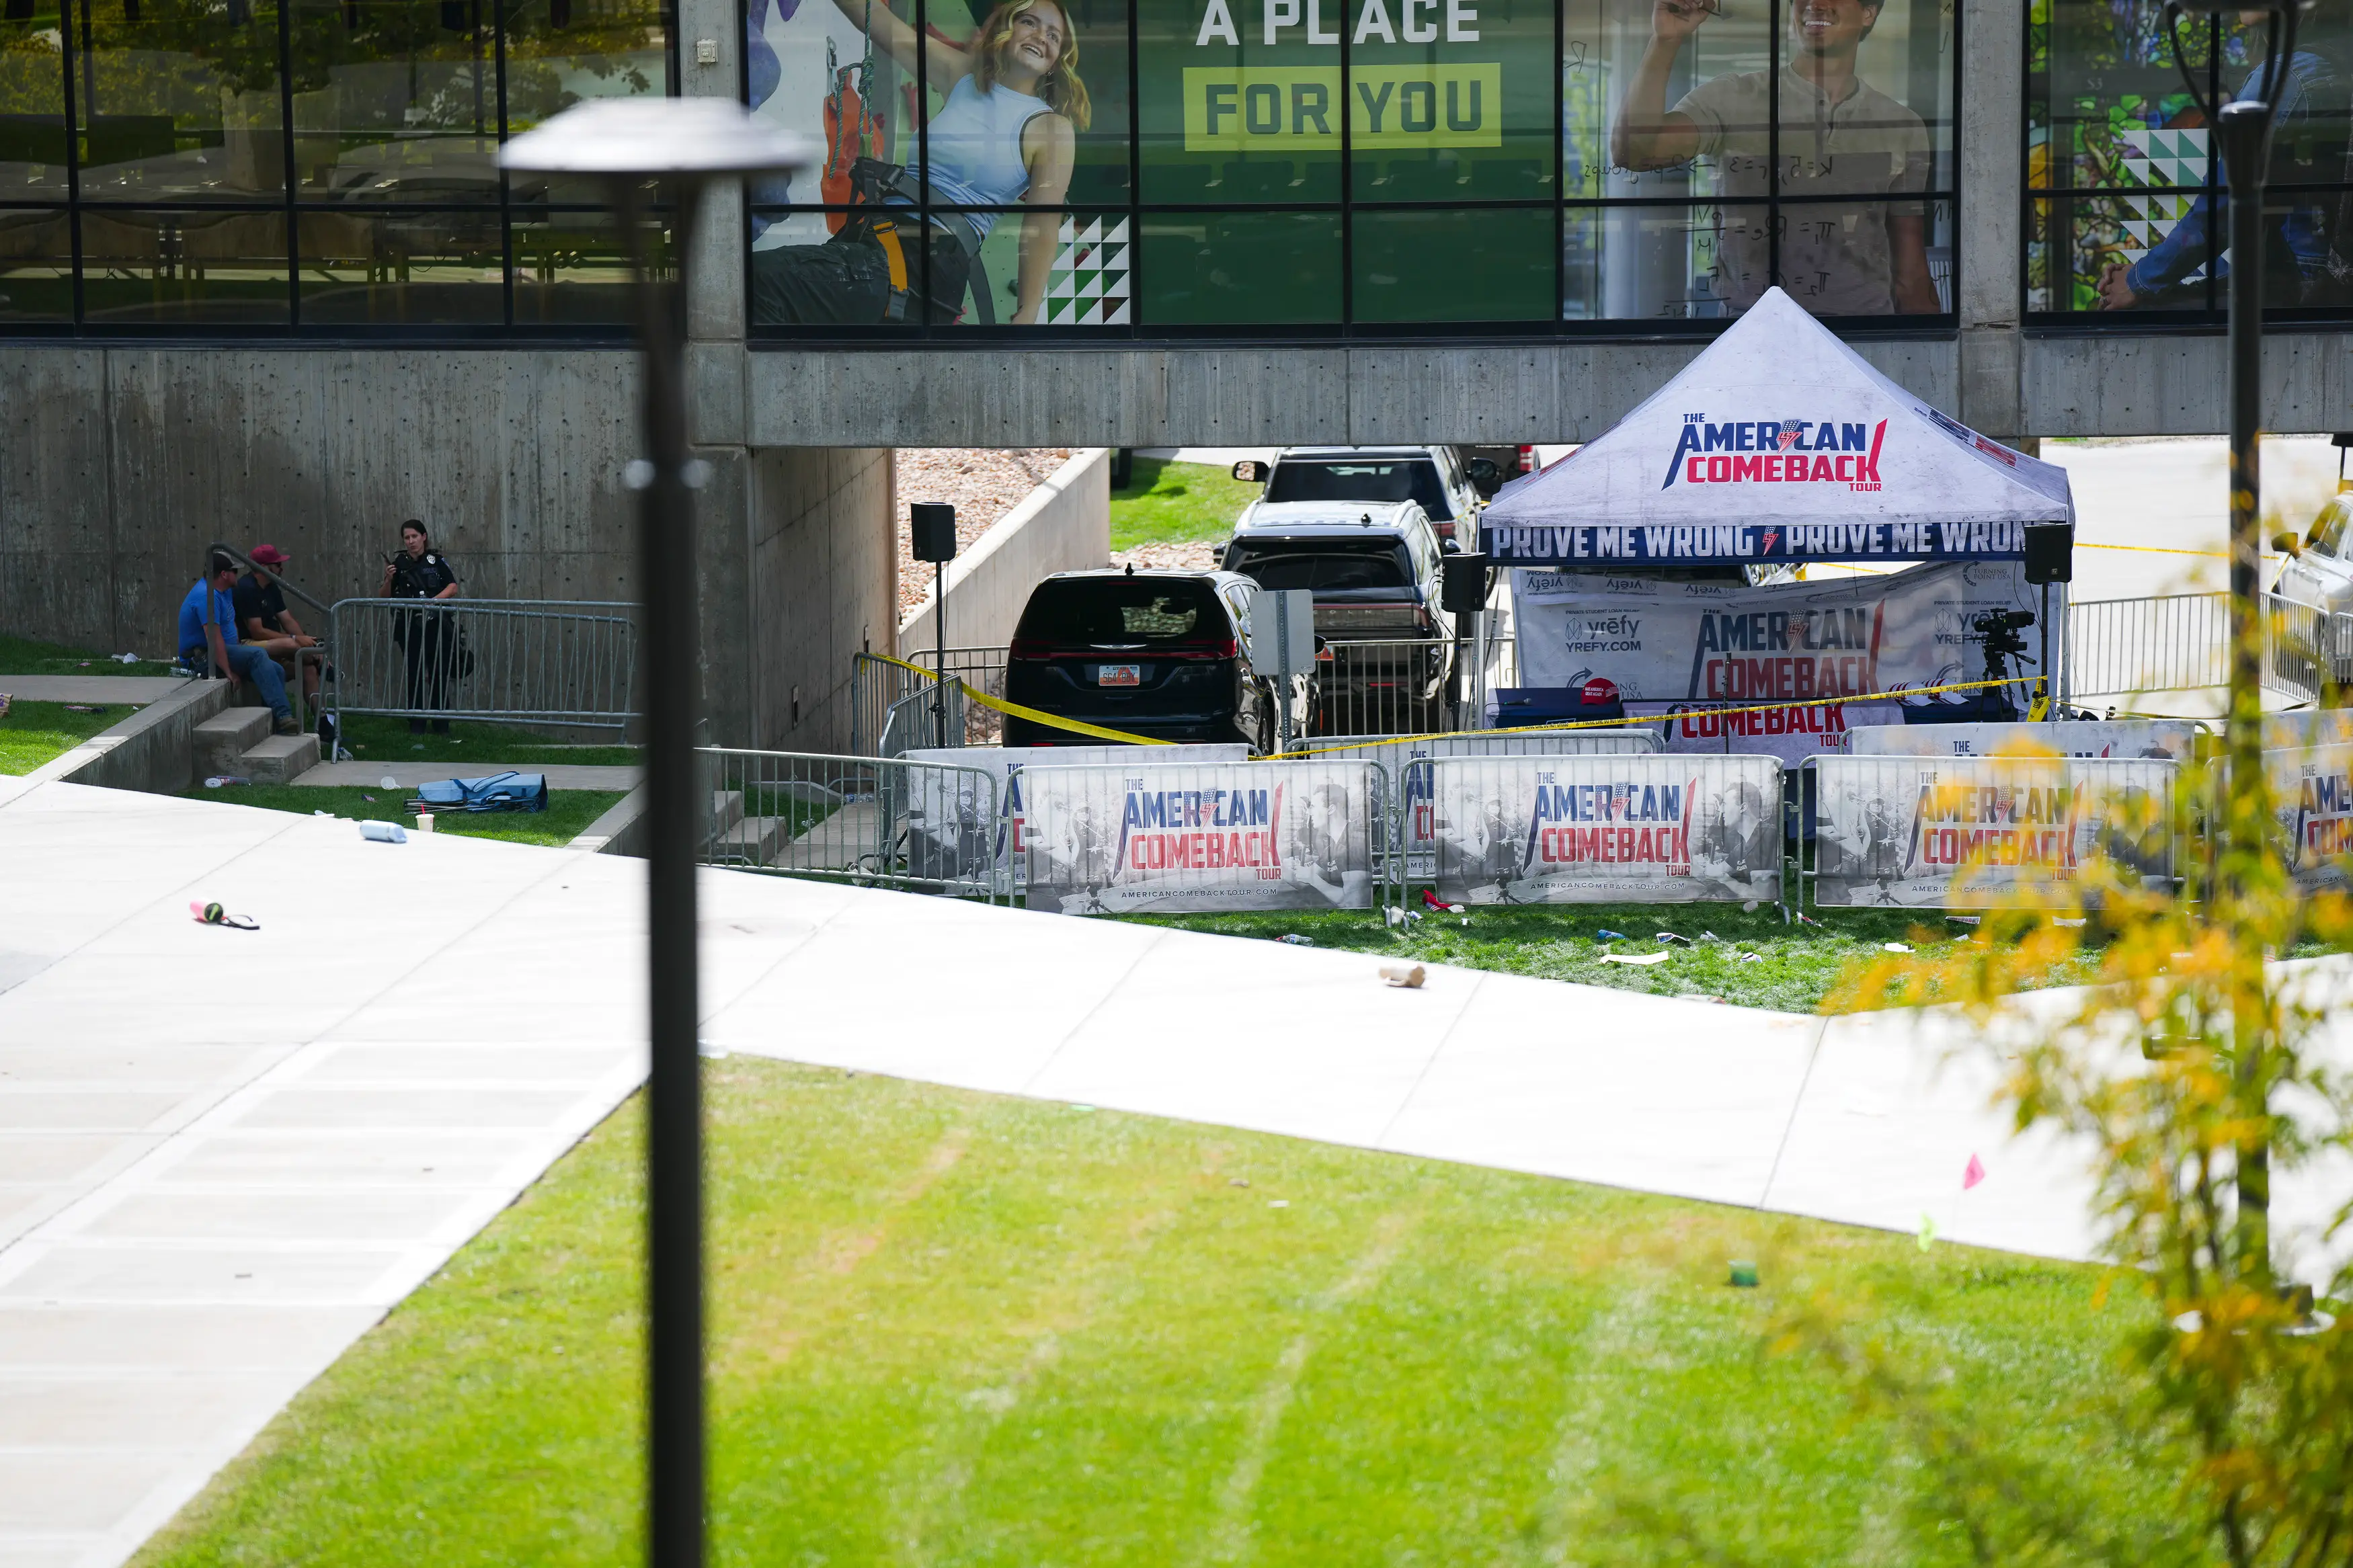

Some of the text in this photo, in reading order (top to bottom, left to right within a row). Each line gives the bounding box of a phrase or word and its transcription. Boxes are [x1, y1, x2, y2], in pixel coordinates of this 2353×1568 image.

[1196, 0, 1479, 45] A PLACE
[1206, 80, 1482, 135] FOR YOU
[1683, 413, 1705, 423] THE
[1848, 483, 1882, 491] TOUR
[1492, 522, 2031, 558] PROVE ME WRONG PROVE ME WRON
[1566, 641, 1642, 653] YREFY.COM
[1953, 741, 1970, 752] THE
[2301, 764, 2316, 777] THE
[1125, 778, 1143, 790] THE
[1537, 772, 1554, 784] THE
[1921, 772, 1938, 784] THE
[1256, 868, 1281, 880] TOUR
[1665, 864, 1691, 876] TOUR
[2052, 868, 2077, 880] TOUR
[1121, 889, 1277, 898] AMERICANCOMEBACKTOUR.COM
